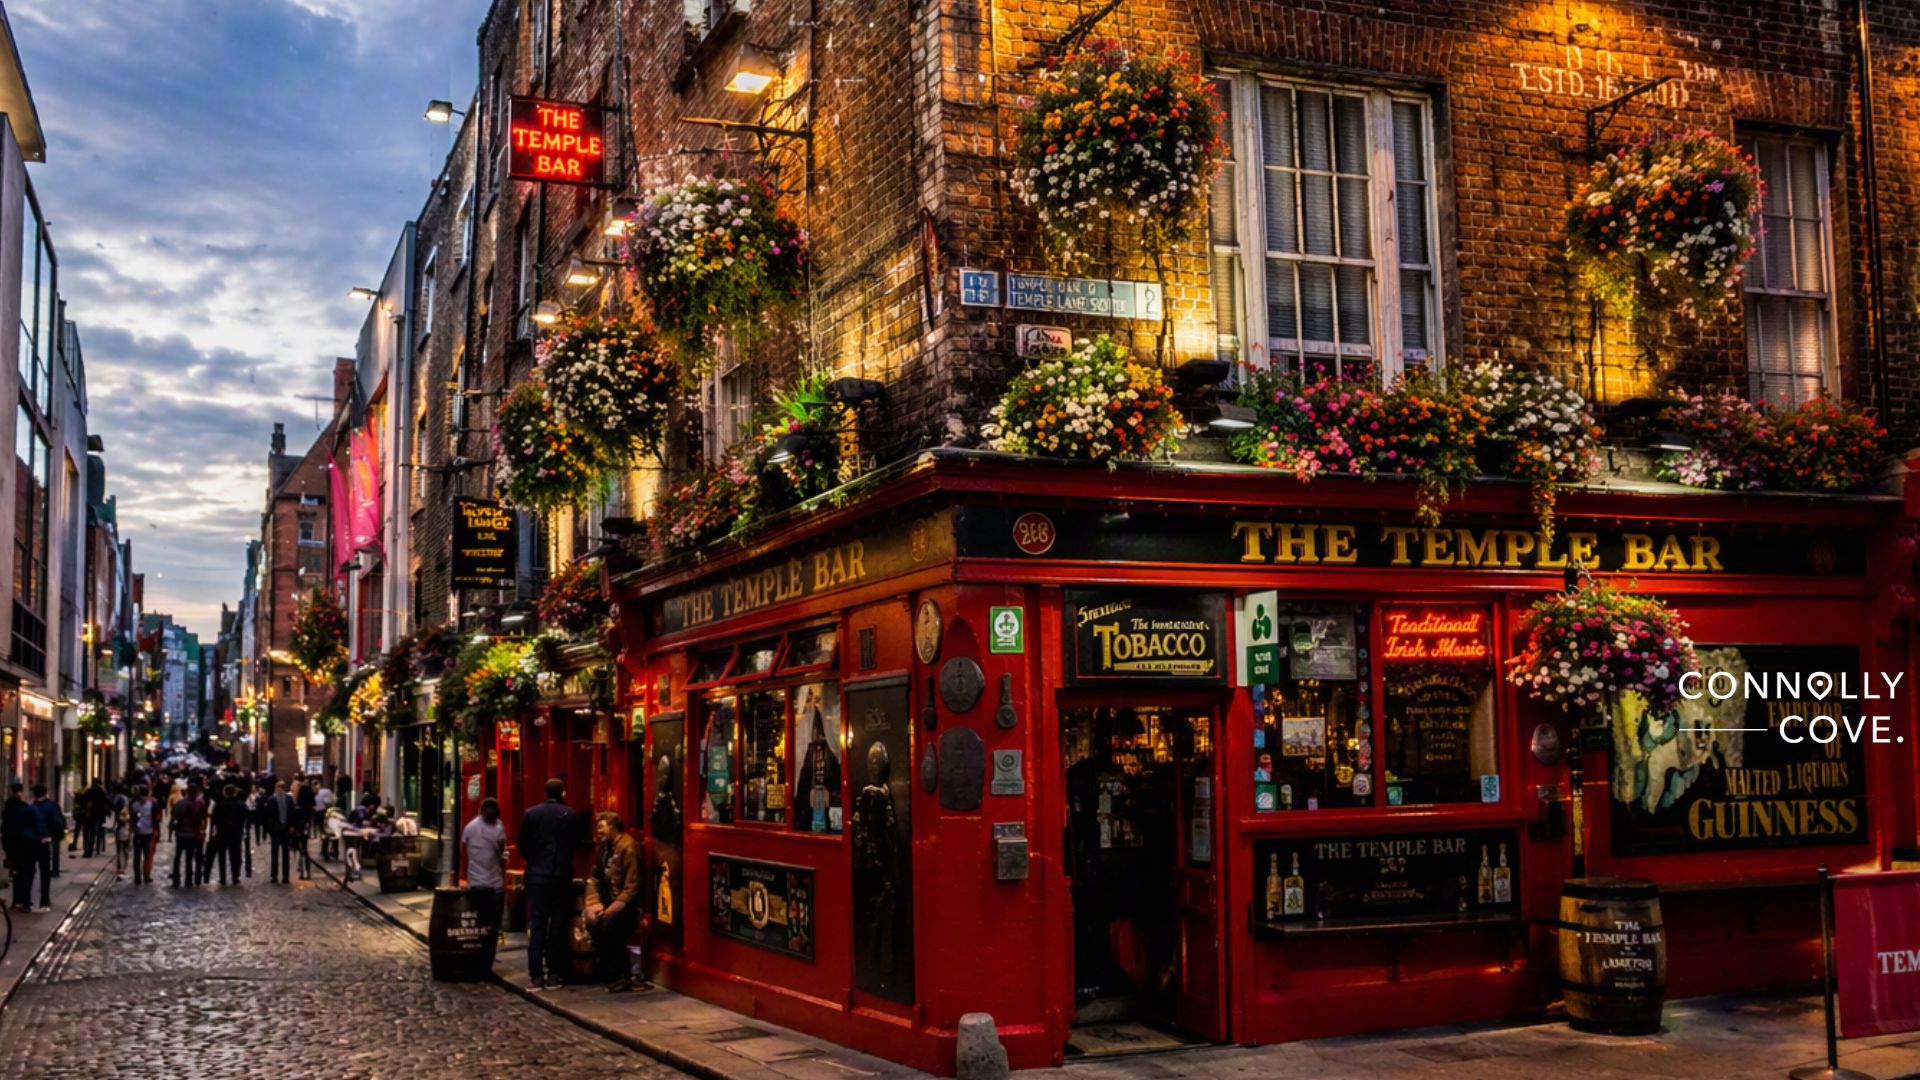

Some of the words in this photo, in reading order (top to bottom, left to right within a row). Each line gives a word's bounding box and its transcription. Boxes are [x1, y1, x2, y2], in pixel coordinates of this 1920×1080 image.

[538, 108, 581, 130] THE
[512, 128, 601, 155] TEMPLE
[537, 155, 581, 176] BAR
[1010, 291, 1053, 308] TEMPLE
[1233, 521, 1359, 565] THE
[1380, 526, 1601, 570] TEMPLE
[1622, 532, 1725, 573] BAR
[681, 590, 714, 629] THE
[721, 557, 804, 617] TEMPLE
[812, 539, 867, 592] BAR
[1093, 622, 1206, 671] TOBACCO
[1431, 637, 1486, 657] Music
[1724, 768, 1781, 796] MALTED
[1787, 761, 1848, 793] LIQUORS
[1688, 798, 1858, 841] GUINNESS
[1314, 842, 1353, 860] THE
[1356, 839, 1426, 858] TEMPLE
[1432, 838, 1467, 854] BAR
